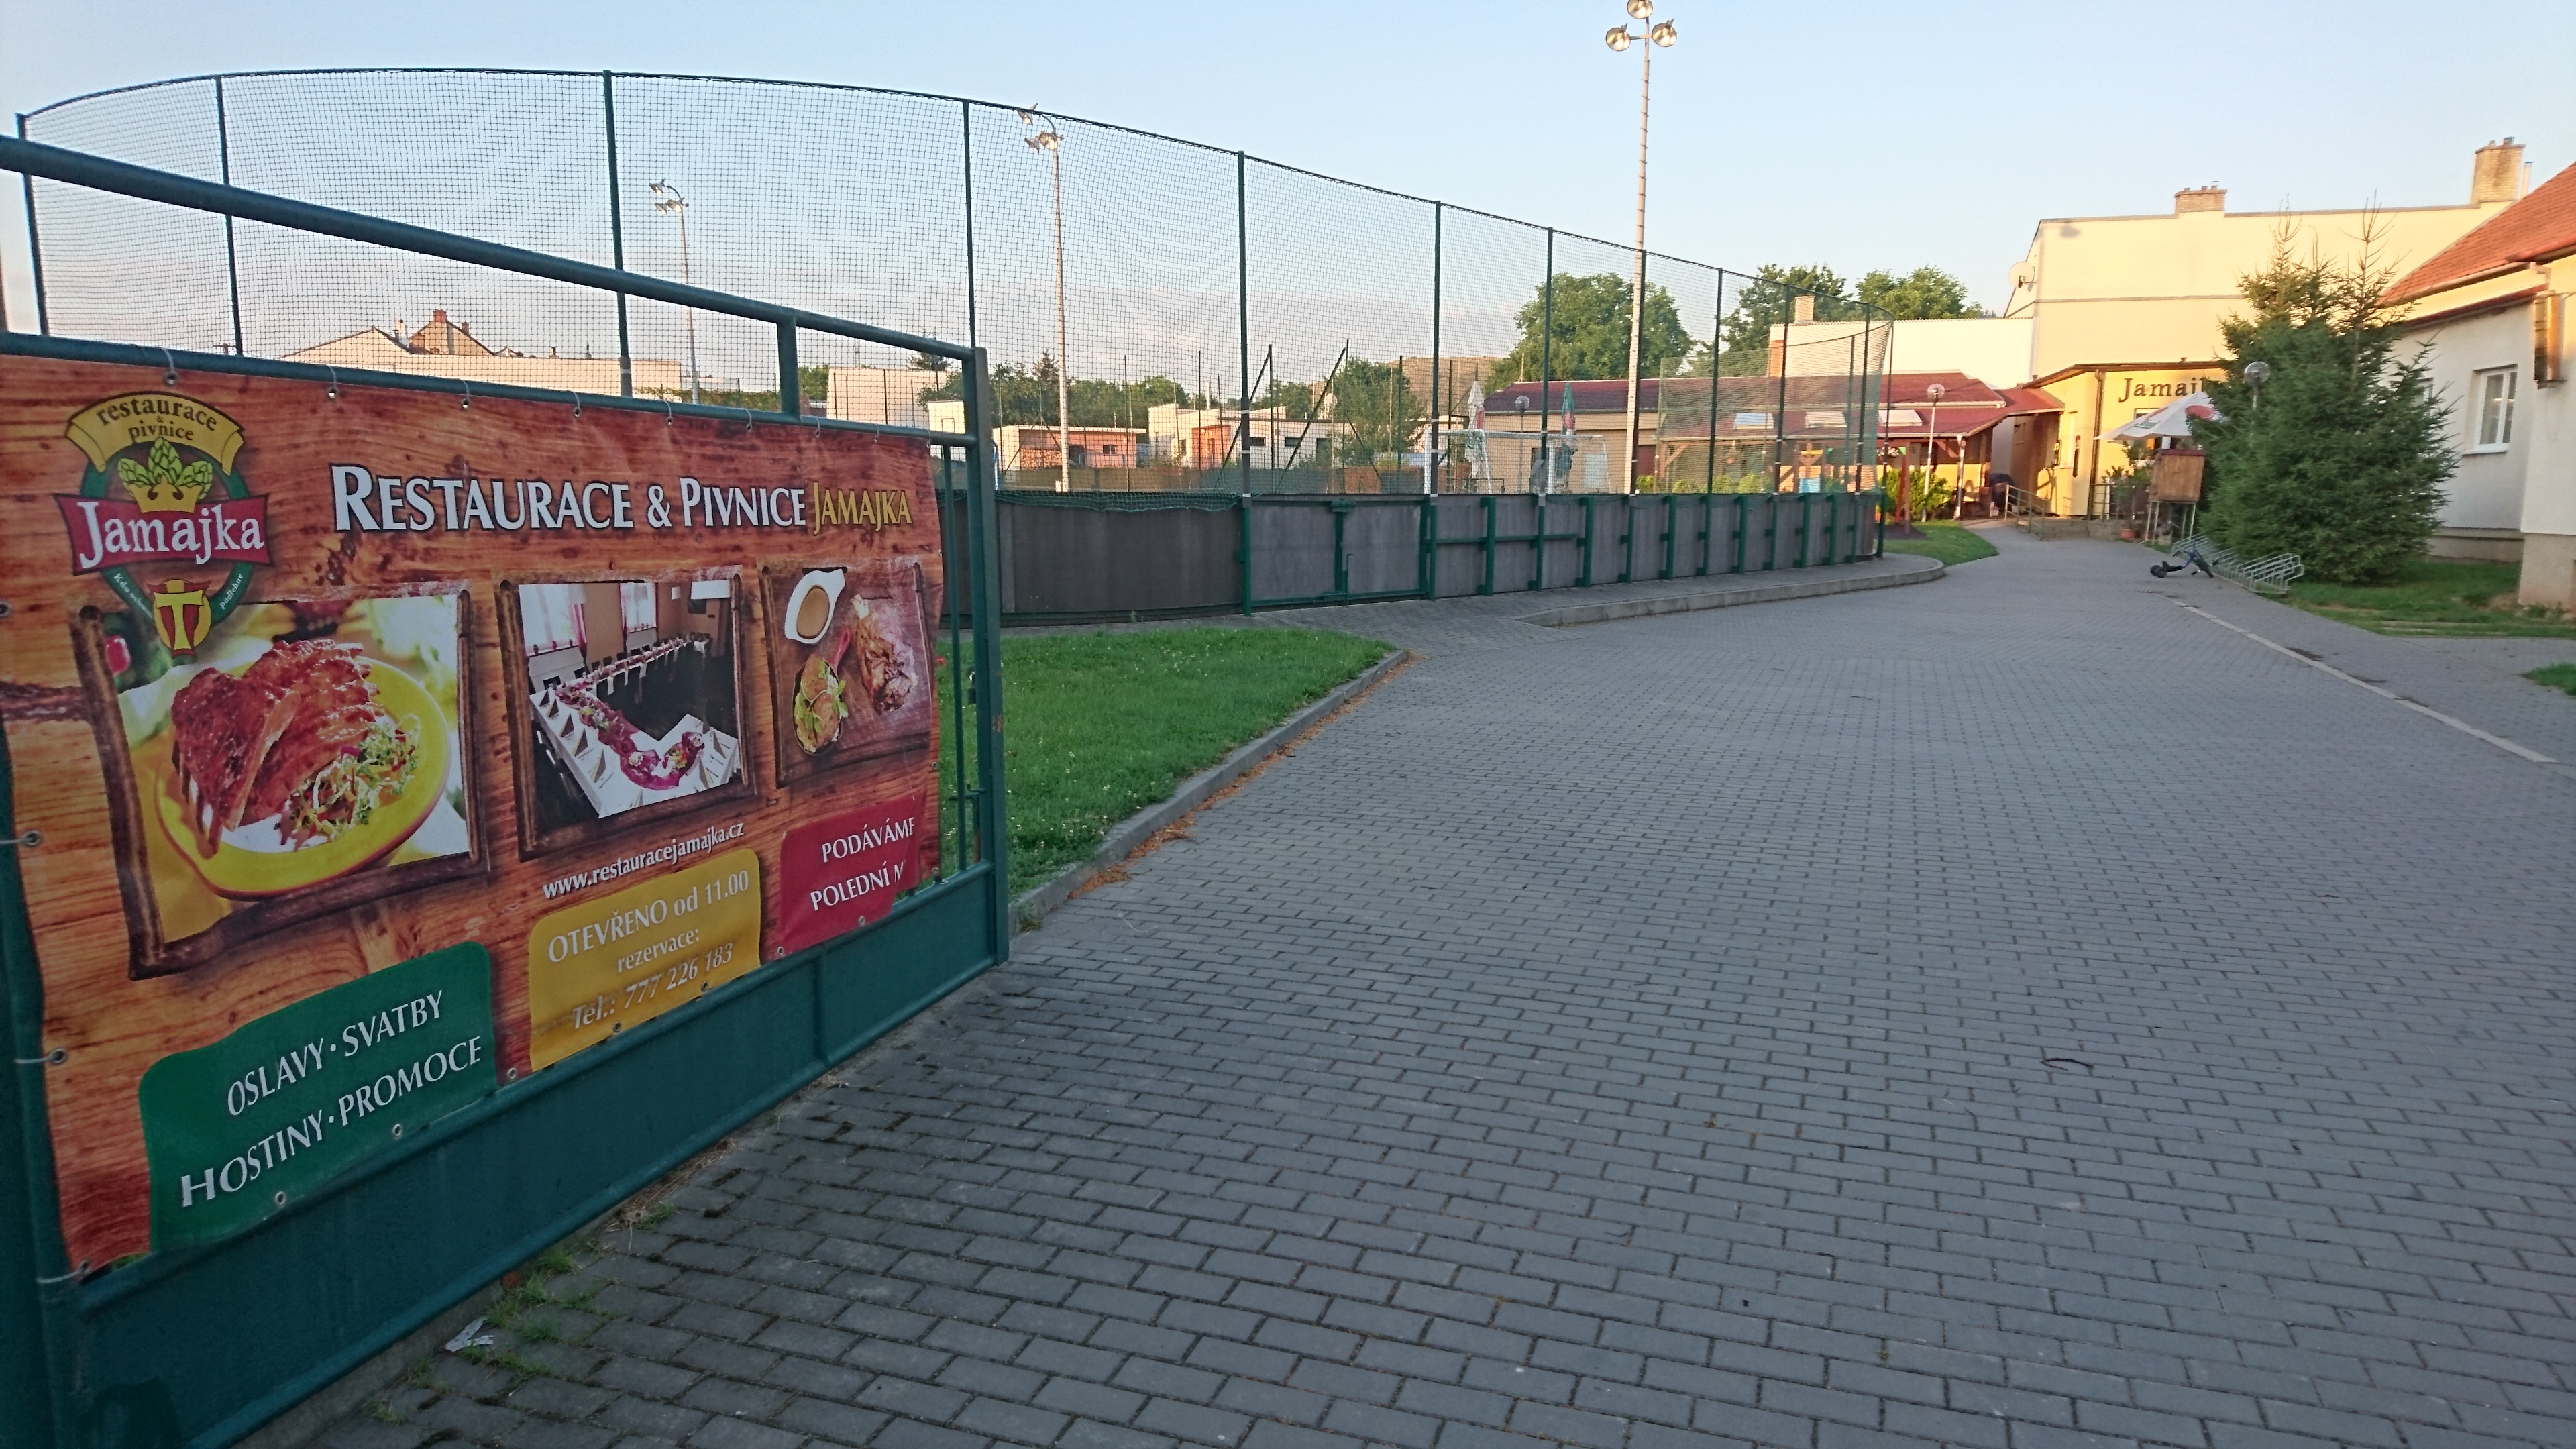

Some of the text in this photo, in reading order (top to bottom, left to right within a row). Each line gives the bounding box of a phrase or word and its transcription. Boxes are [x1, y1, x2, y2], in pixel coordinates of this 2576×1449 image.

[96, 398, 217, 431] restaurace
[127, 419, 194, 443] pivnice
[330, 464, 913, 535] RESTAURACE & PIVNICE JAMAJKA
[77, 501, 265, 569] Jamajka
[219, 573, 244, 610] podlehne
[542, 822, 745, 899] www.restauracejamajka.cz
[821, 817, 914, 863] PODÁVÁME
[810, 861, 890, 911] POLEDNÍ
[547, 870, 749, 963] OTEVŘENO od 11.00
[616, 928, 700, 973] rezervace:
[572, 942, 733, 1030] Tel.: 777 226 183
